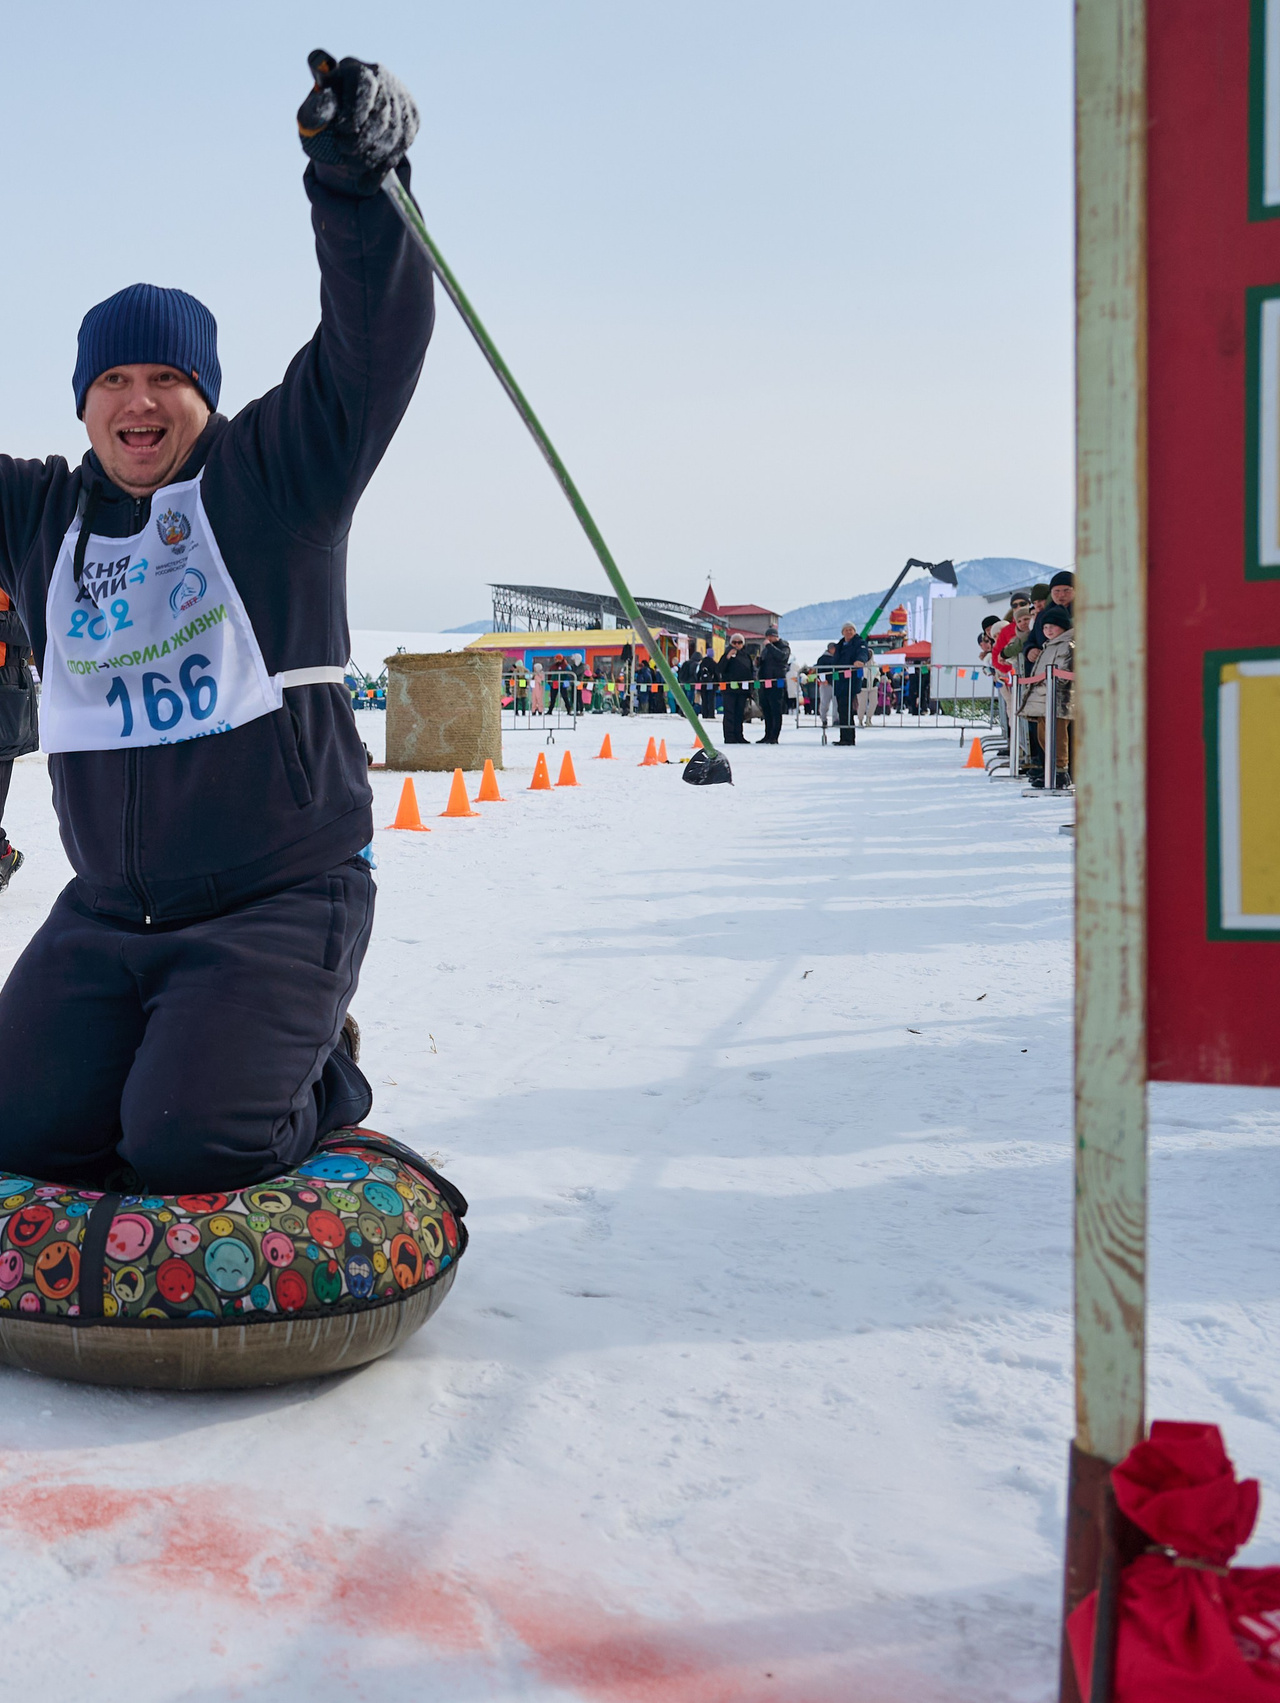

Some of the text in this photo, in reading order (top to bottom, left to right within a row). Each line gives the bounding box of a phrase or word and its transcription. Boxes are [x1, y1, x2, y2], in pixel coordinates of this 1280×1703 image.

[67, 604, 228, 675] СПОРТ НОРМА ЖИЗНИ
[105, 653, 218, 738] 166
